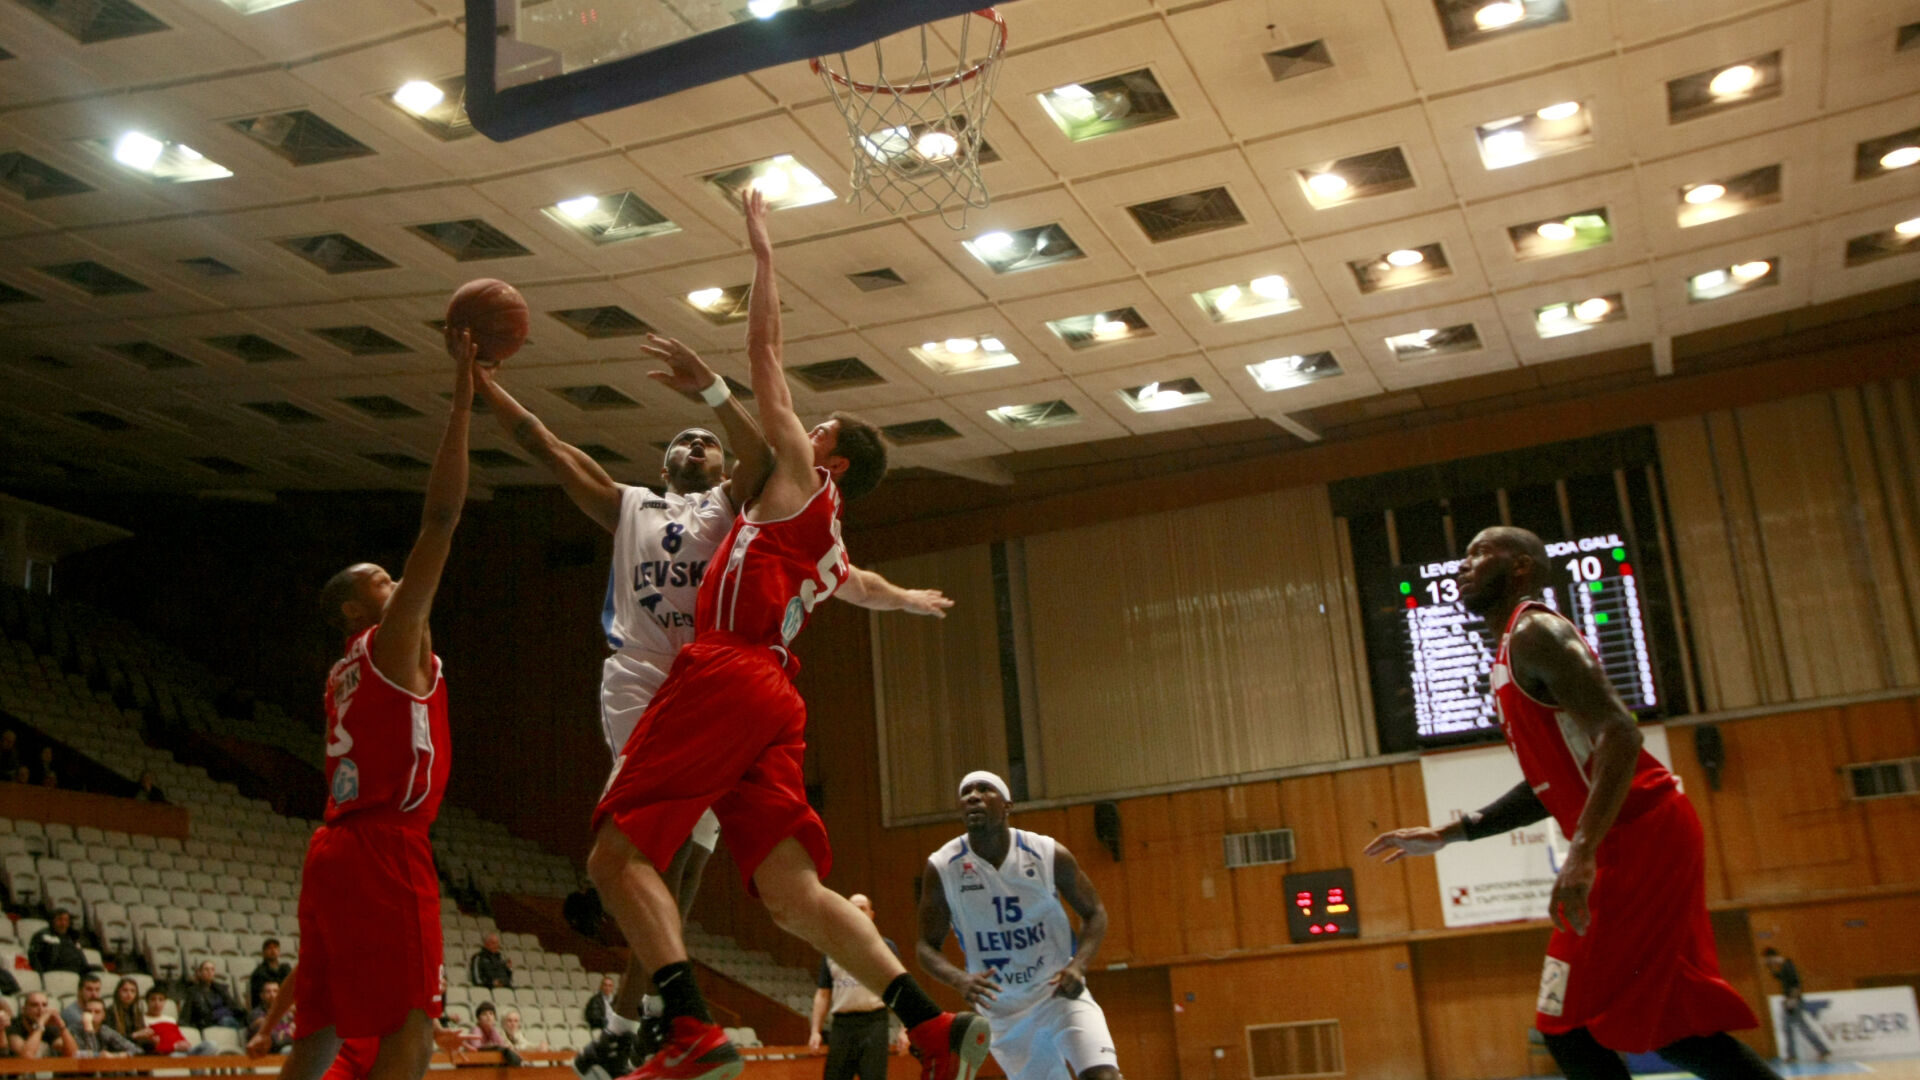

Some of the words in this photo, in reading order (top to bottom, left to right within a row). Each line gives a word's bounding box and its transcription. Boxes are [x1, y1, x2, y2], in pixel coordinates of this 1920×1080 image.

[661, 522, 684, 554] 8
[1544, 540, 1580, 558] BOA
[1578, 533, 1625, 552] GALIL
[633, 560, 709, 591] LEVSK
[1419, 558, 1466, 579] LEVS
[1565, 556, 1602, 583] 10
[1425, 578, 1460, 604] 13
[992, 896, 1023, 925] 15
